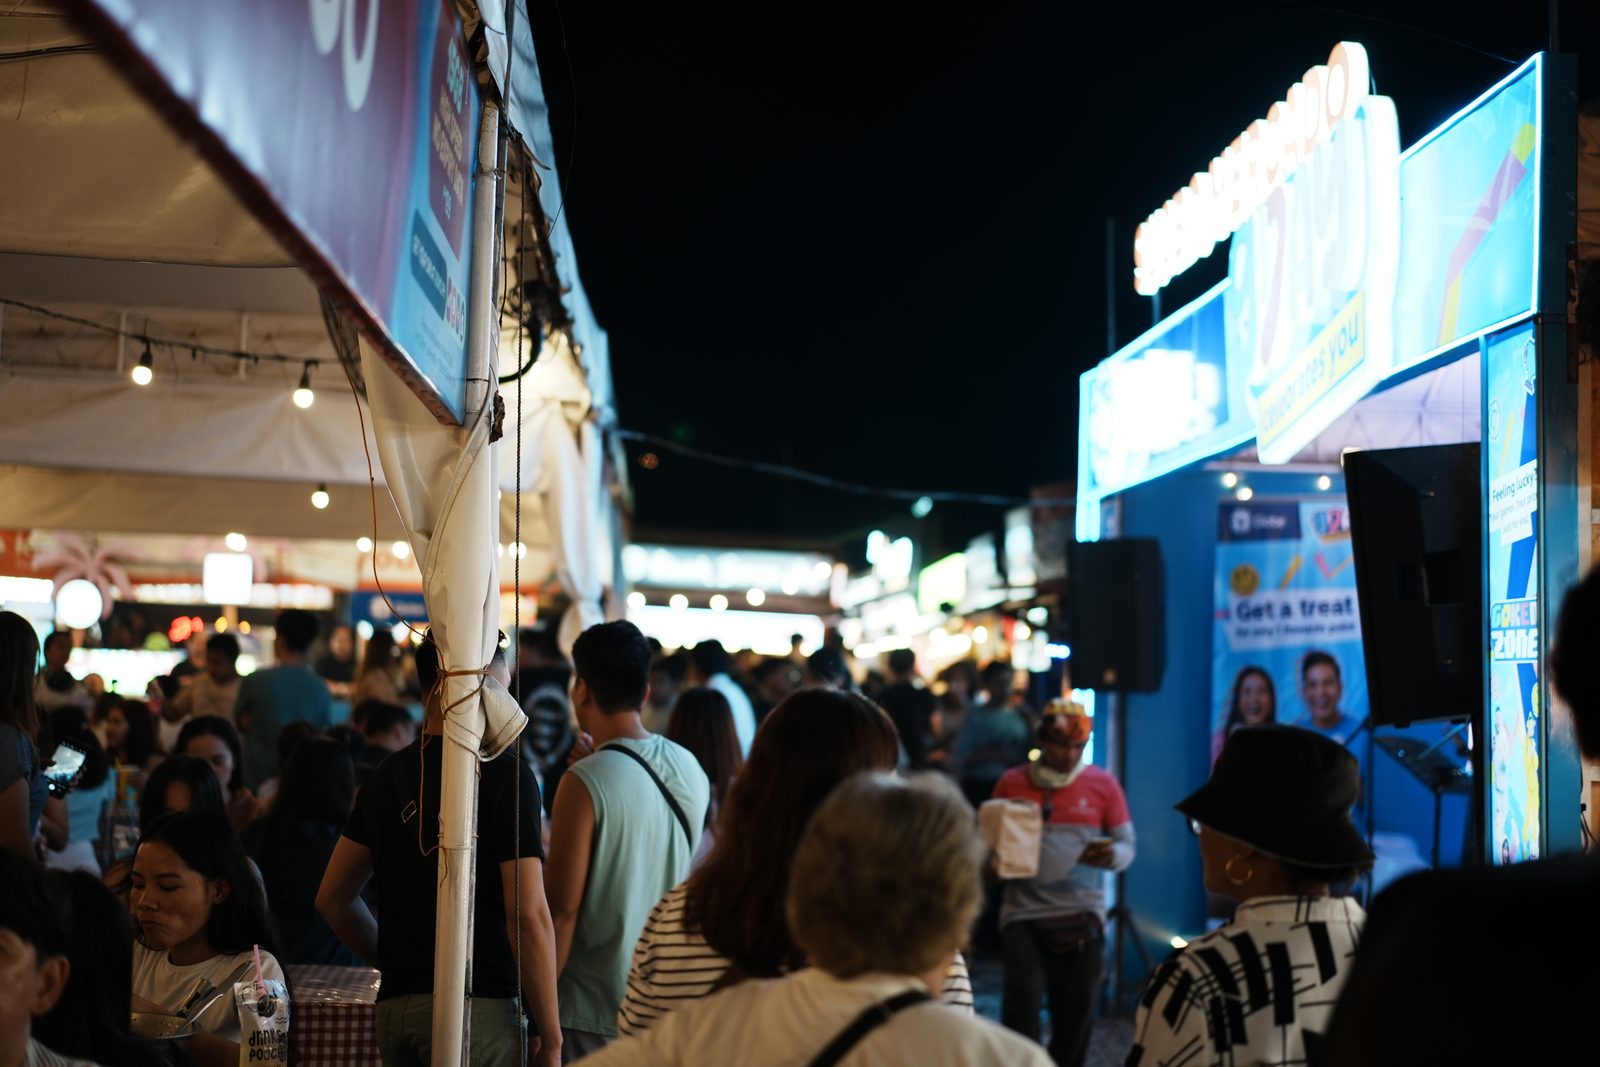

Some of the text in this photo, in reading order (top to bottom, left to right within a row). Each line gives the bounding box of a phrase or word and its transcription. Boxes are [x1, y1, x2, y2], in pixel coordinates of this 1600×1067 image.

[1329, 311, 1359, 381] you
[1492, 483, 1515, 503] Feeling
[1237, 597, 1352, 621] Get a treat
[1490, 628, 1538, 659] ZONE
